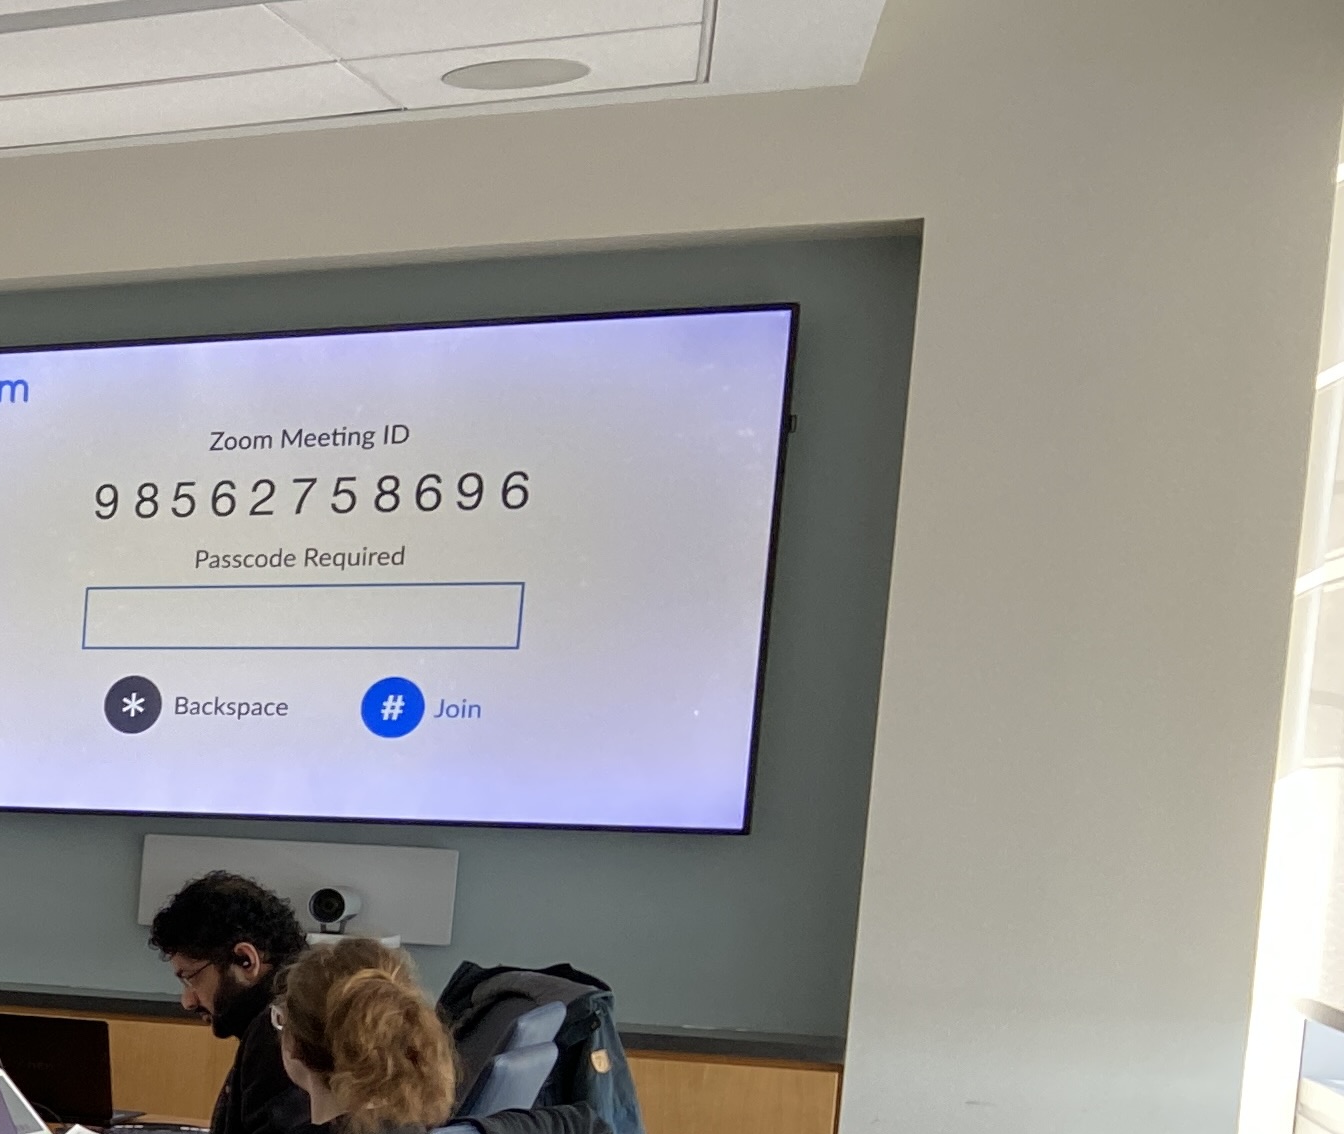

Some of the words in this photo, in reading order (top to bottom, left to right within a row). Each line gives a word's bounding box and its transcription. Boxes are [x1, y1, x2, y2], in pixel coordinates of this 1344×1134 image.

[207, 428, 274, 453] Zoom
[279, 425, 377, 452] Meeting
[382, 423, 411, 447] ID
[194, 546, 298, 571] Passcode
[303, 543, 407, 573] Required
[173, 694, 289, 724] Backspace
[432, 696, 483, 721] Join
